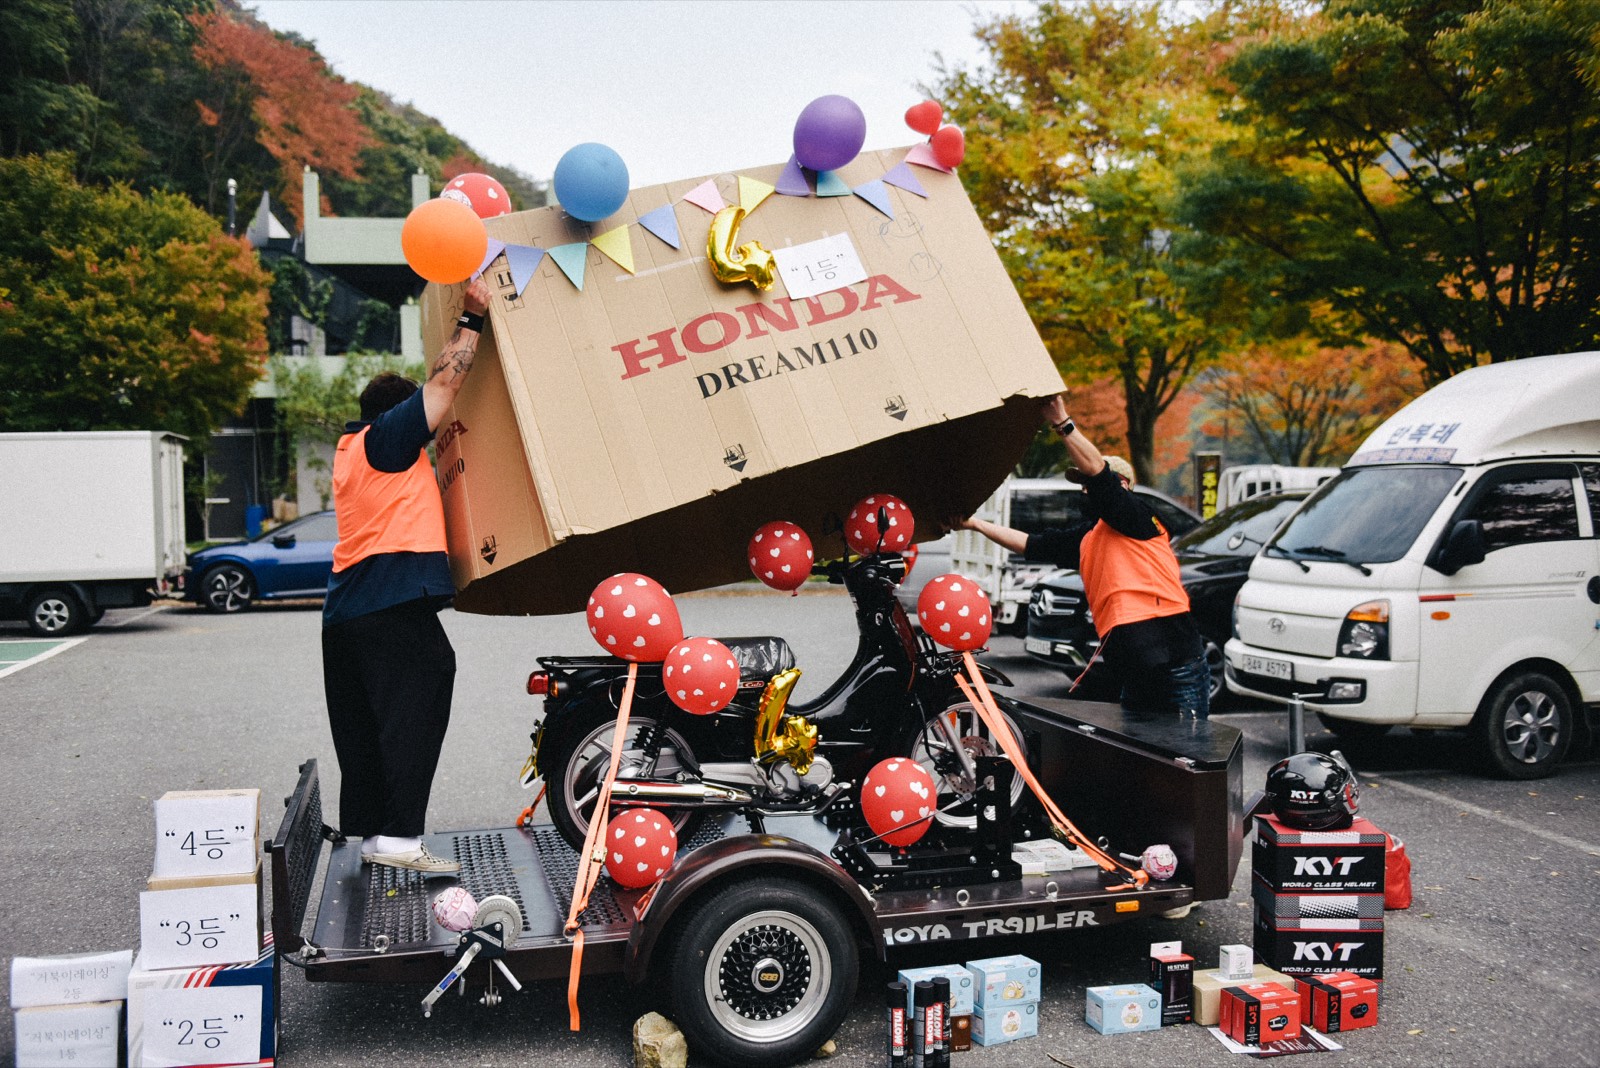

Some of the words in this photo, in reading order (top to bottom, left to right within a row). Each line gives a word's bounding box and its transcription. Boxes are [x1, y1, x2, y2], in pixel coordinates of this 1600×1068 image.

[611, 274, 922, 380] HONDA
[693, 327, 879, 400] DREAM110
[436, 420, 468, 460] NDA
[1290, 790, 1320, 800] KYT
[1293, 856, 1365, 876] KYT
[1293, 941, 1365, 962] KYT
[63, 987, 81, 999] 2등
[1249, 1012, 1257, 1024] 3
[1331, 1002, 1338, 1014] 2
[894, 1010, 902, 1044] MOTUL
[934, 1004, 942, 1038] MOTUL
[60, 1048, 76, 1060] 1등
